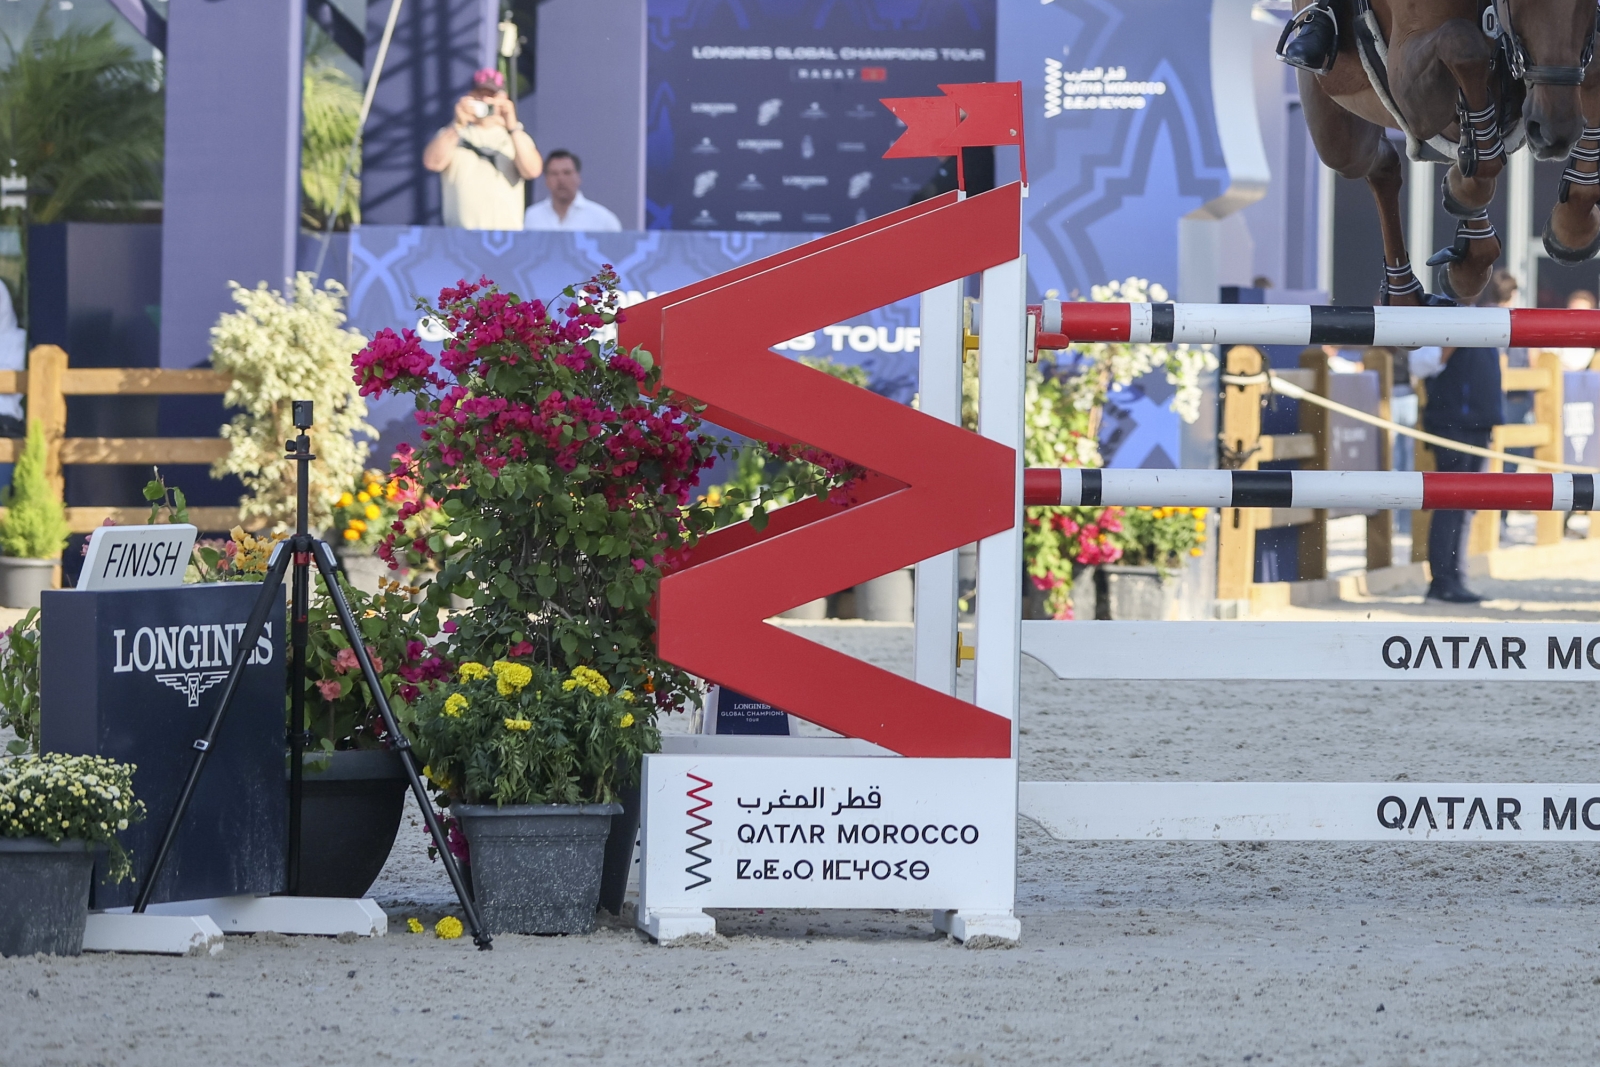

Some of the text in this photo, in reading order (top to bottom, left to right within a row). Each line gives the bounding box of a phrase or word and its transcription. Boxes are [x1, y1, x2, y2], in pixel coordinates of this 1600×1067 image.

[693, 46, 985, 61] LONGINES GLOBAL CHAMPIONS TOUR
[103, 542, 182, 578] FINISH
[1382, 636, 1526, 670] QATAR
[737, 786, 881, 815] قطر المغرب
[1377, 796, 1521, 830] QATAR
[738, 824, 979, 844] QATAR MOROCCO
